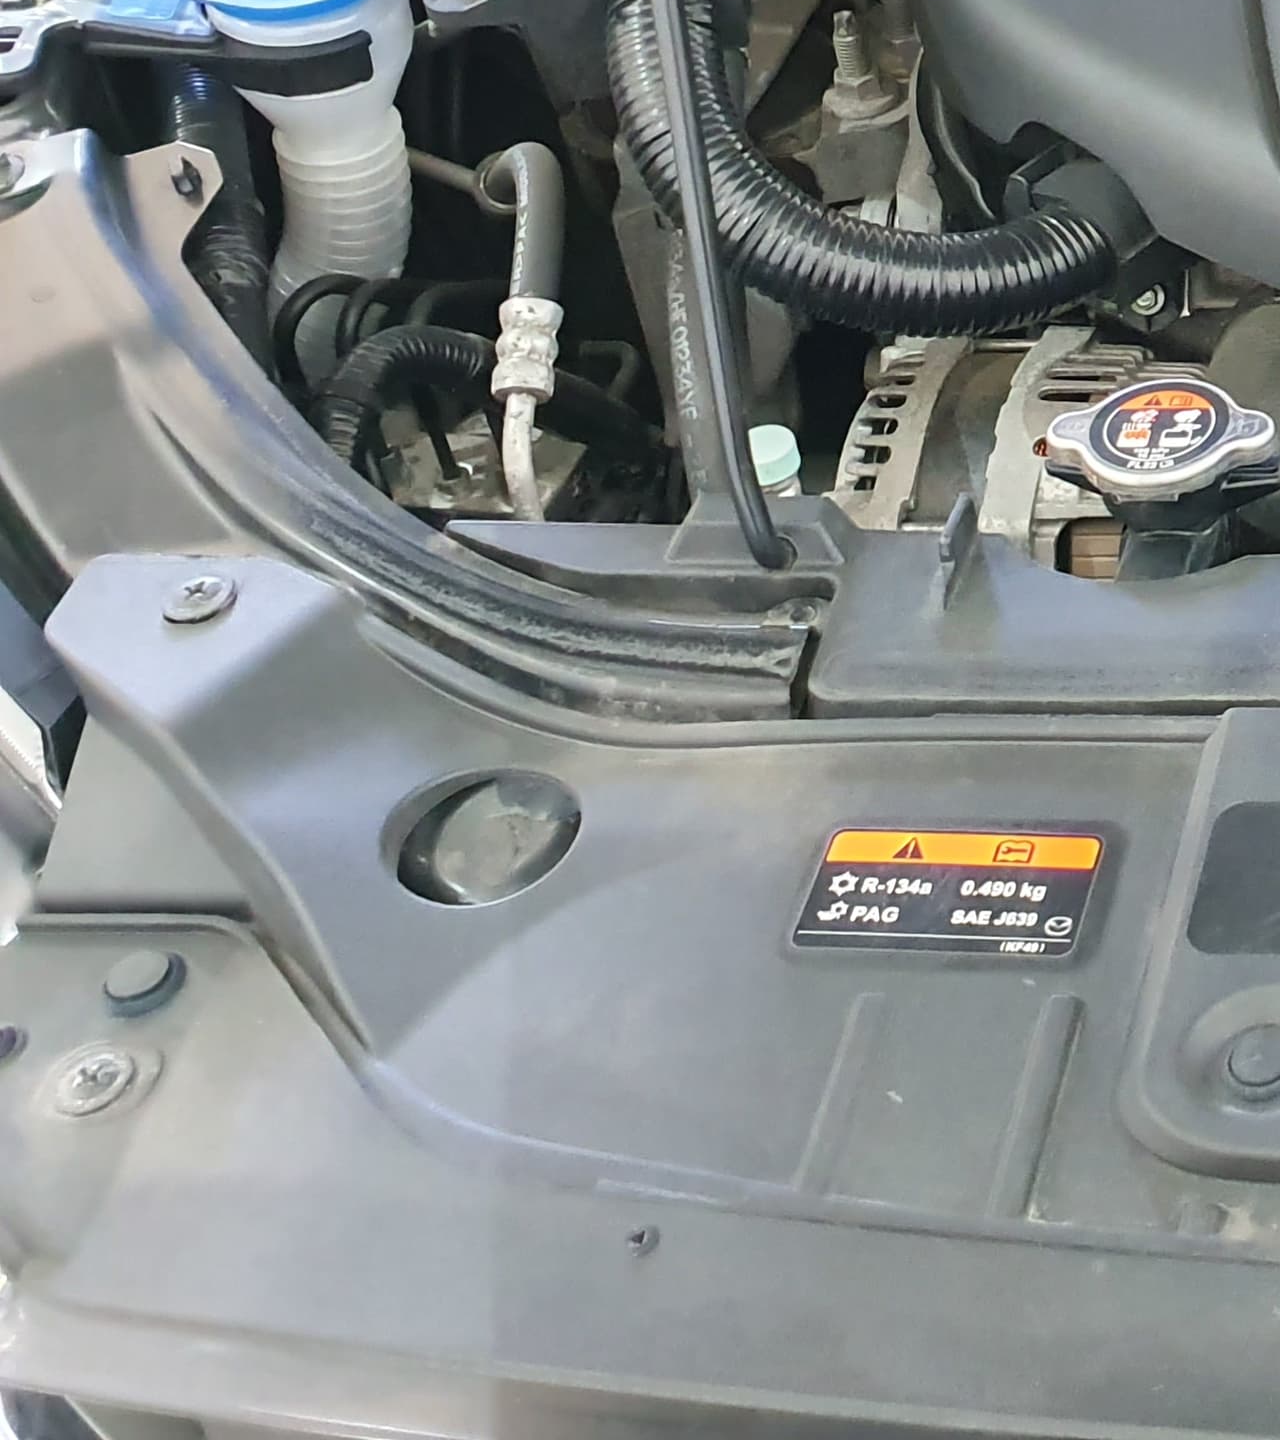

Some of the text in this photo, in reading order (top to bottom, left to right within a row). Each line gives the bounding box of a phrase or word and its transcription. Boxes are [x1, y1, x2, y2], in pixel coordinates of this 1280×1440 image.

[861, 876, 933, 895] R-134a
[1019, 882, 1047, 902] kg
[850, 905, 900, 923] PAG
[950, 909, 992, 925] SAE
